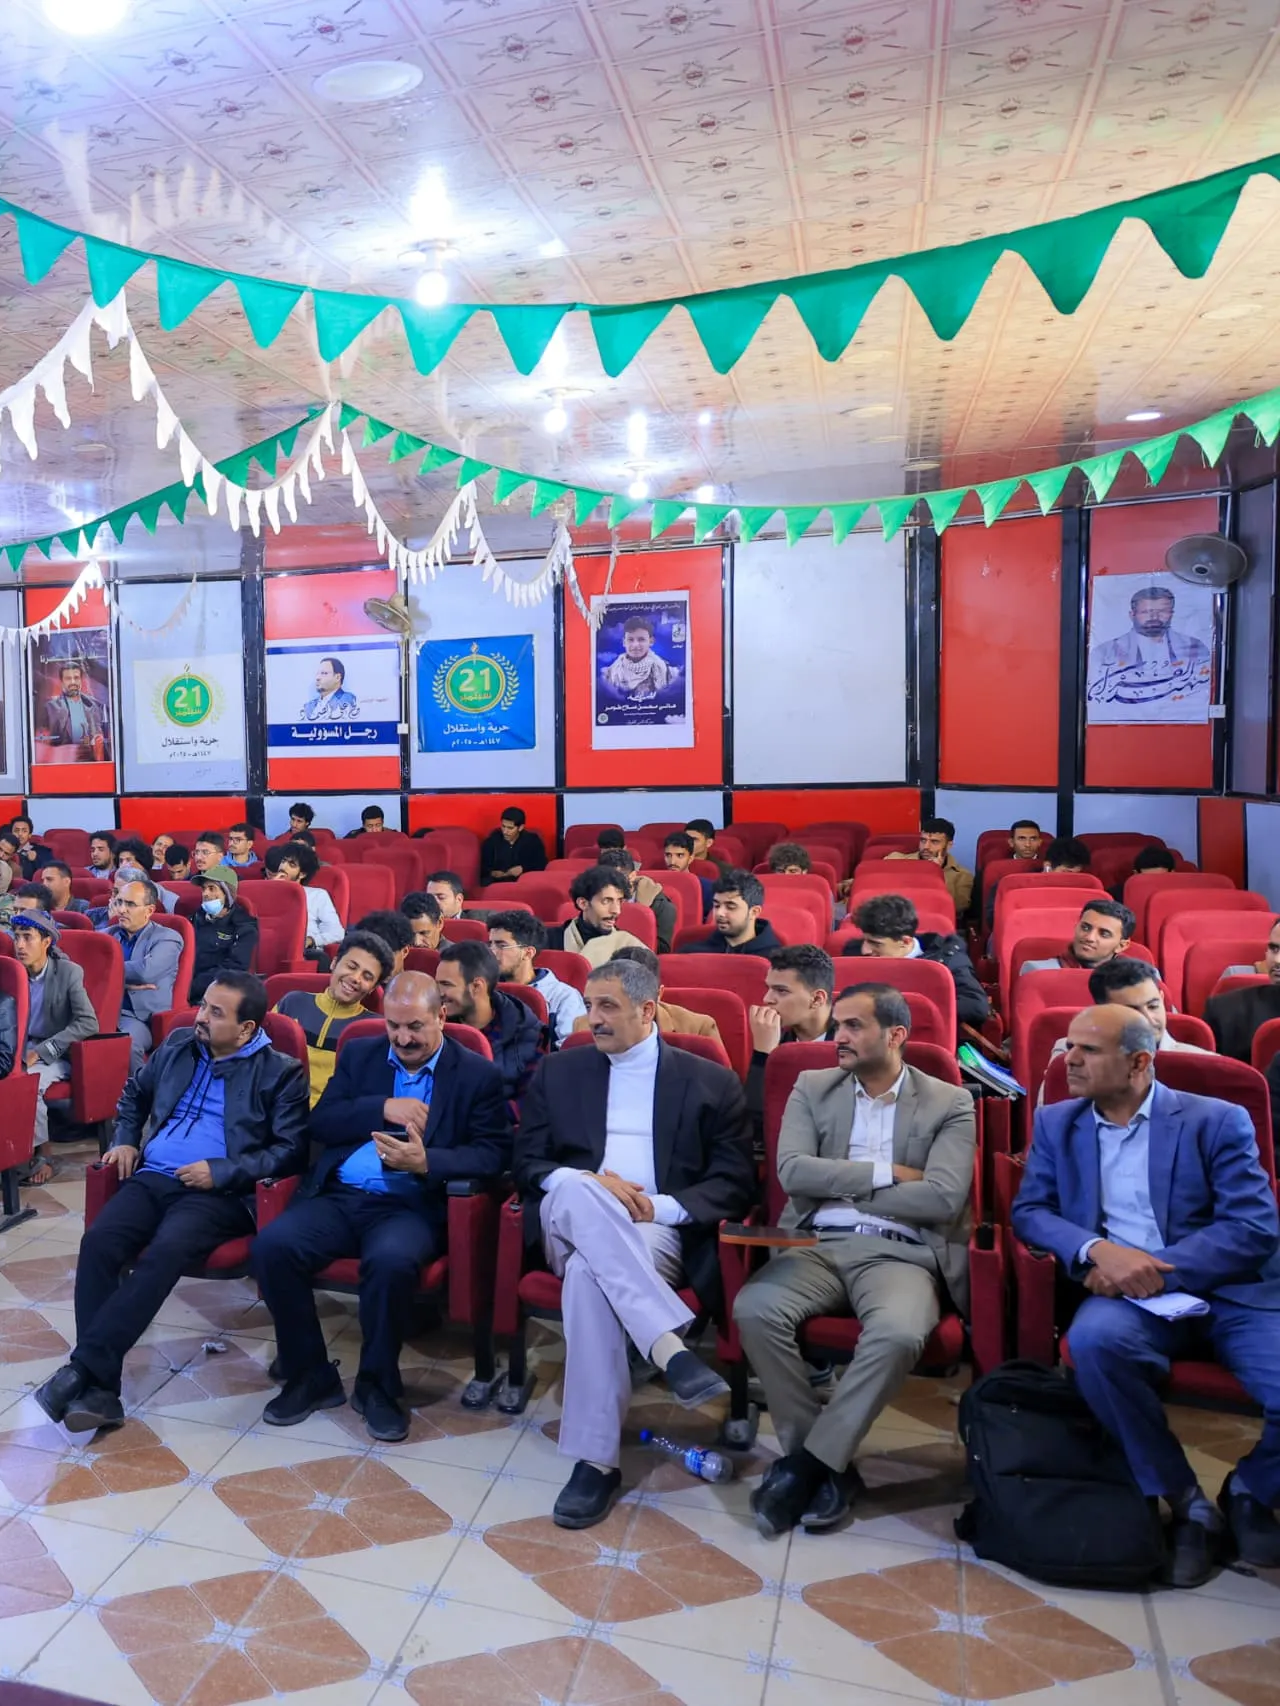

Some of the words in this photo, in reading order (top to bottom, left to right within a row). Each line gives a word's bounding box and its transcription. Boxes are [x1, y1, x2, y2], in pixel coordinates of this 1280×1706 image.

[459, 667, 491, 692] 21
[174, 685, 202, 708] 21
[344, 725, 378, 739] رجل
[443, 723, 486, 735] واستقلال
[487, 722, 510, 734] حرية
[161, 736, 198, 748] واستقلال
[200, 736, 218, 747] حرية
